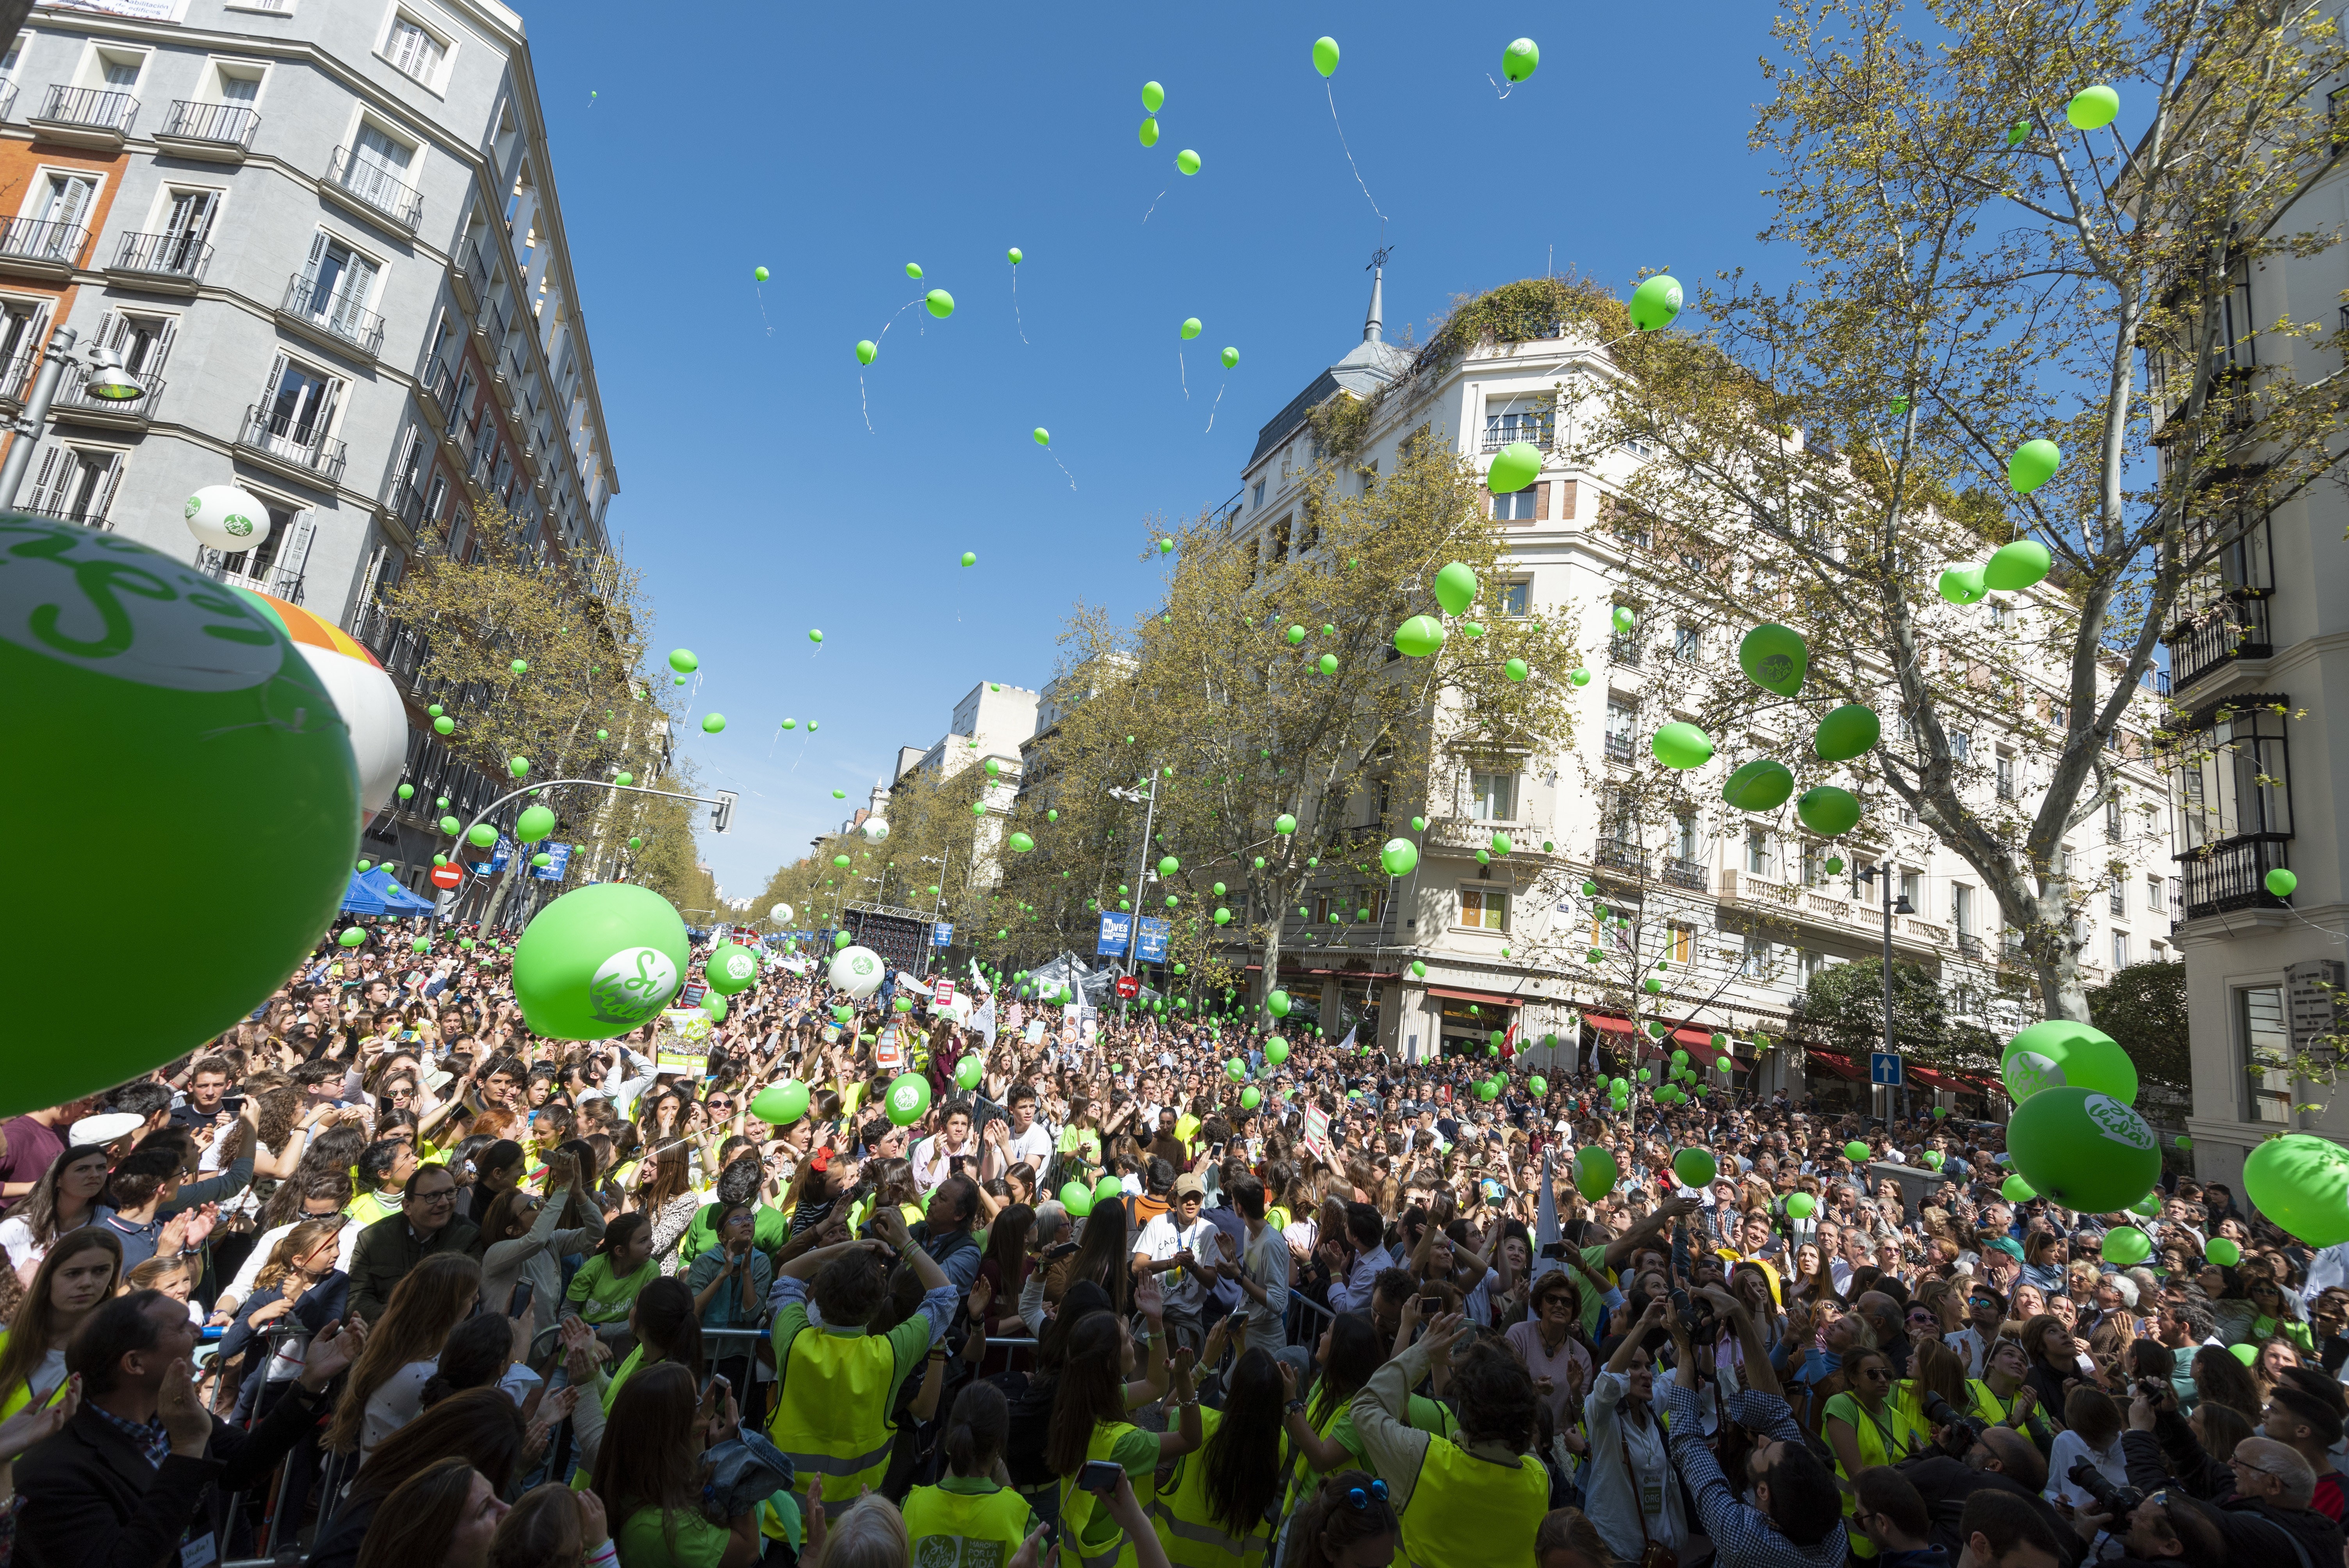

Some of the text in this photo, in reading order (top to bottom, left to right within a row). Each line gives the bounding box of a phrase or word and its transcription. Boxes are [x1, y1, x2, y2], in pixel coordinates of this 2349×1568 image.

[129, 7, 160, 15] edificios
[233, 515, 248, 529] Sí
[1104, 922, 1128, 933] NAVES
[737, 955, 748, 969] Sí
[859, 956, 869, 968] Sí
[624, 950, 666, 998] Sí
[729, 963, 750, 977] Vida!
[592, 973, 663, 1020] Vida!
[980, 1009, 995, 1029] IMPO
[2018, 1053, 2048, 1083] Sí
[902, 1087, 913, 1099] Sí
[895, 1095, 916, 1107] Vida!
[2107, 1097, 2142, 1126] Sí
[2089, 1103, 2151, 1148] Vida!
[1157, 1280, 1193, 1295] IMPORA
[1645, 1494, 1659, 1503] ORG
[929, 1535, 948, 1554] Sí
[968, 1558, 995, 1568] VIDA
